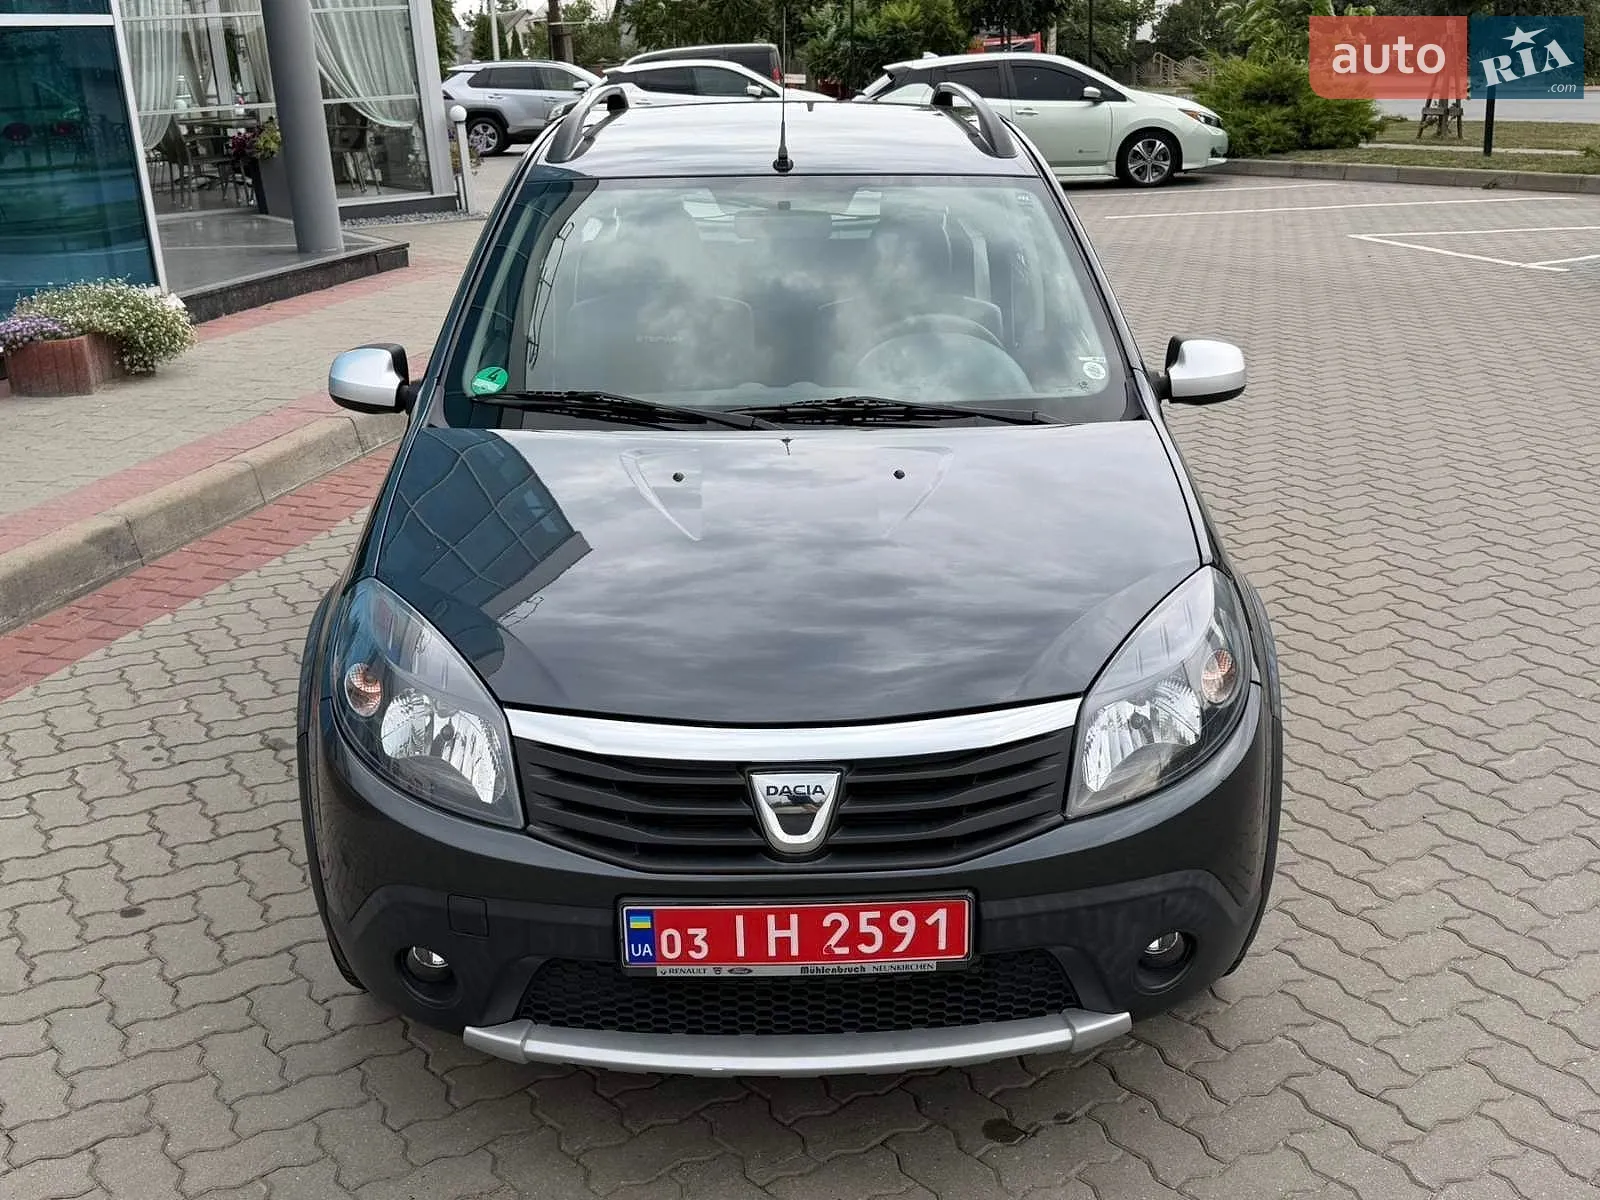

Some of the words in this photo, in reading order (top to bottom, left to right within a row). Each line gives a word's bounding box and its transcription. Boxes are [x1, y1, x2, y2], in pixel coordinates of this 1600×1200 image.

[766, 784, 826, 796] DACIA
[660, 928, 709, 960] 03
[822, 908, 947, 955] 2591
[631, 943, 653, 957] UA
[668, 967, 708, 976] RENAULT
[800, 964, 866, 975] Mühlenbruch
[872, 961, 935, 972] NEUNKIRCHEN
